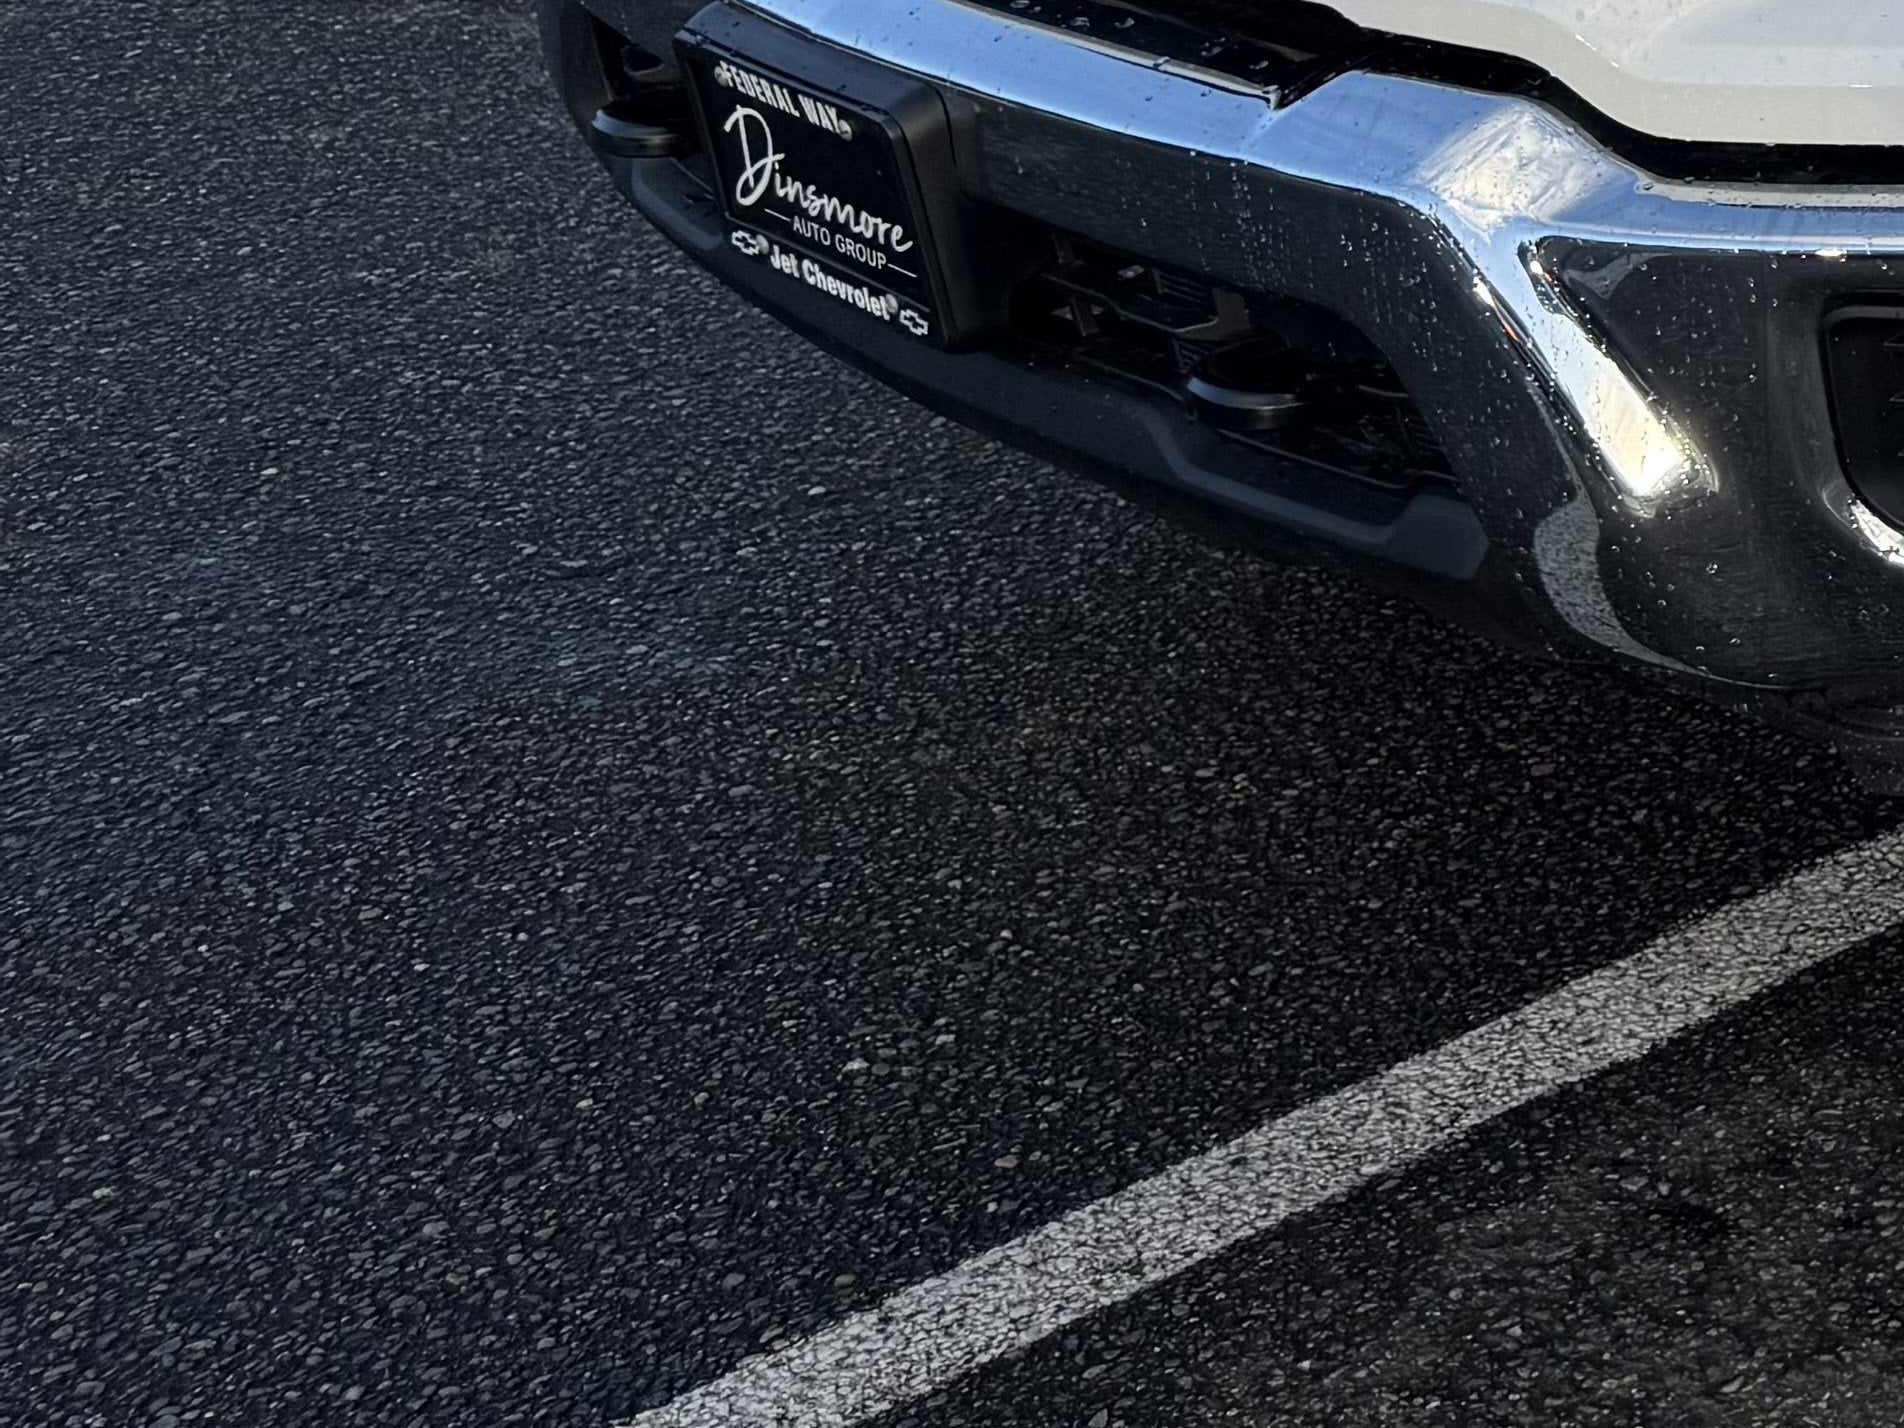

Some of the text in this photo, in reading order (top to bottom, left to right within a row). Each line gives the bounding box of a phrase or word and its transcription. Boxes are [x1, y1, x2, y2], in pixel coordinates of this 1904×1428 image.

[719, 60, 842, 134] FEDERAL WAY
[724, 104, 914, 252] Dinsmore
[792, 215, 887, 270] AUTO GROUP
[770, 243, 891, 322] Jet Chevrolet
